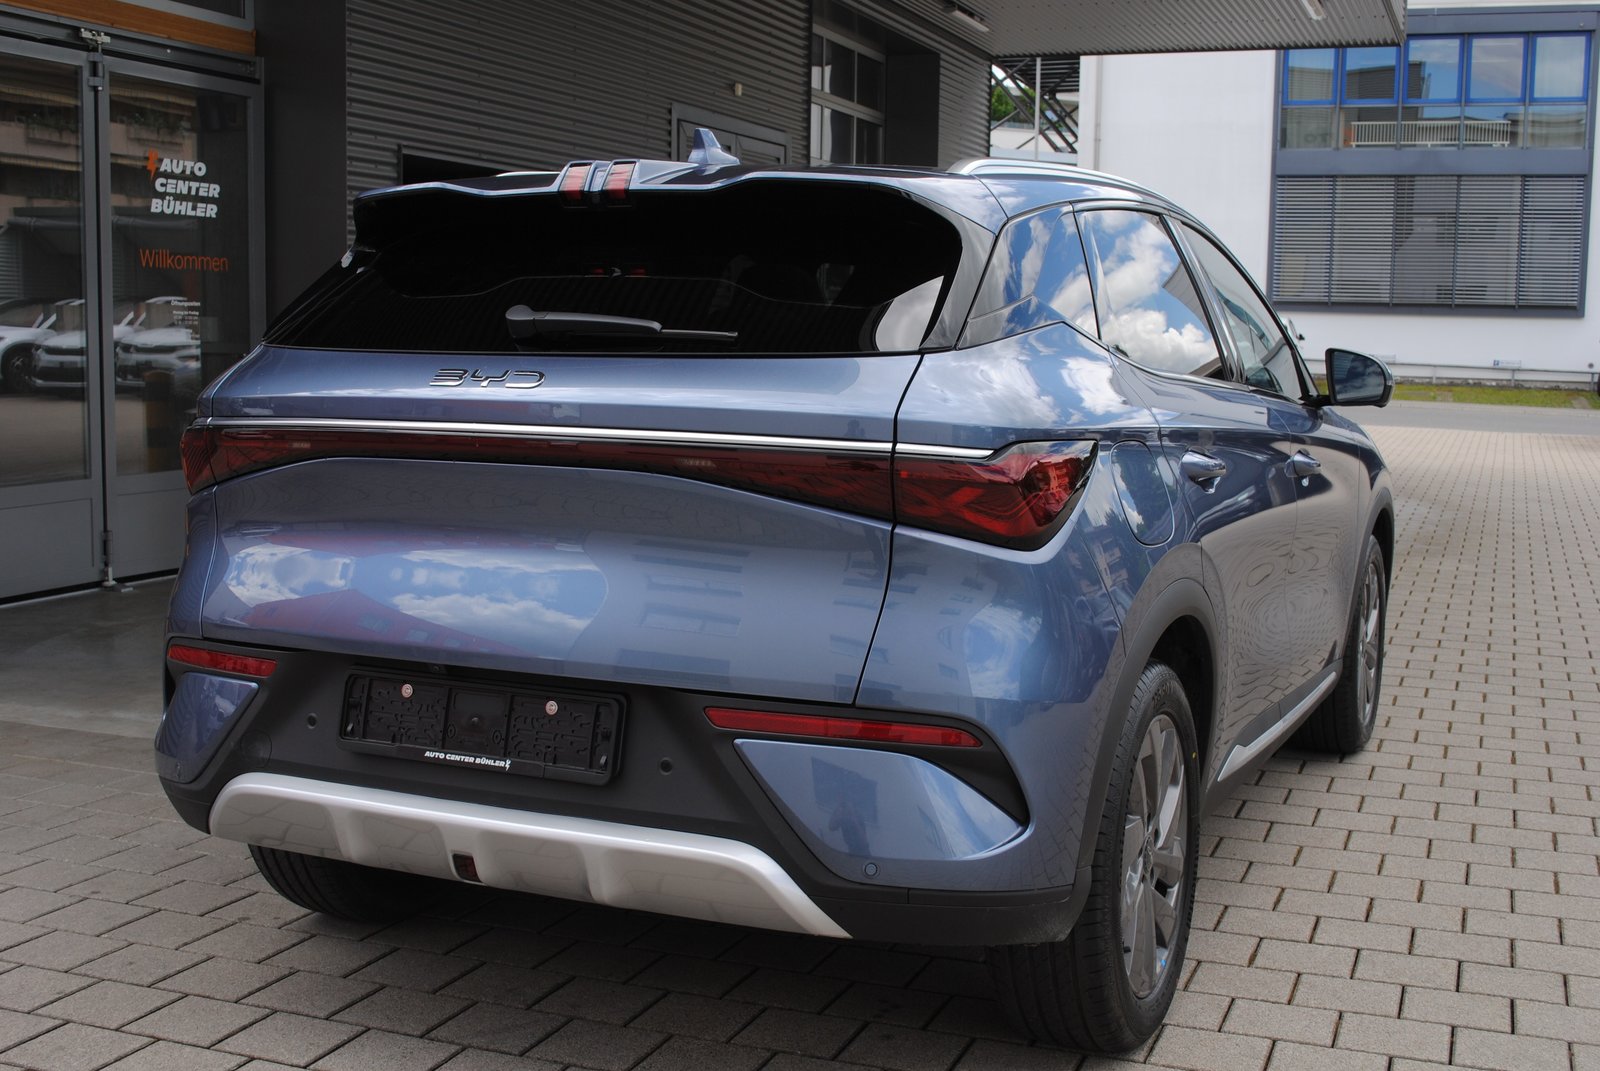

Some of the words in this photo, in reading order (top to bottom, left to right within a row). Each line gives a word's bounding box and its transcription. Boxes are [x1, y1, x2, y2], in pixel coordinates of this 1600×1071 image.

[160, 158, 207, 177] AUTO
[154, 178, 221, 198] CENTER
[150, 196, 218, 218] BÜHLER
[139, 248, 229, 272] Willkommen
[429, 368, 546, 390] BYD
[424, 751, 445, 760] AUTO
[445, 754, 475, 763] CENTER
[475, 757, 506, 767] BÜHLER
